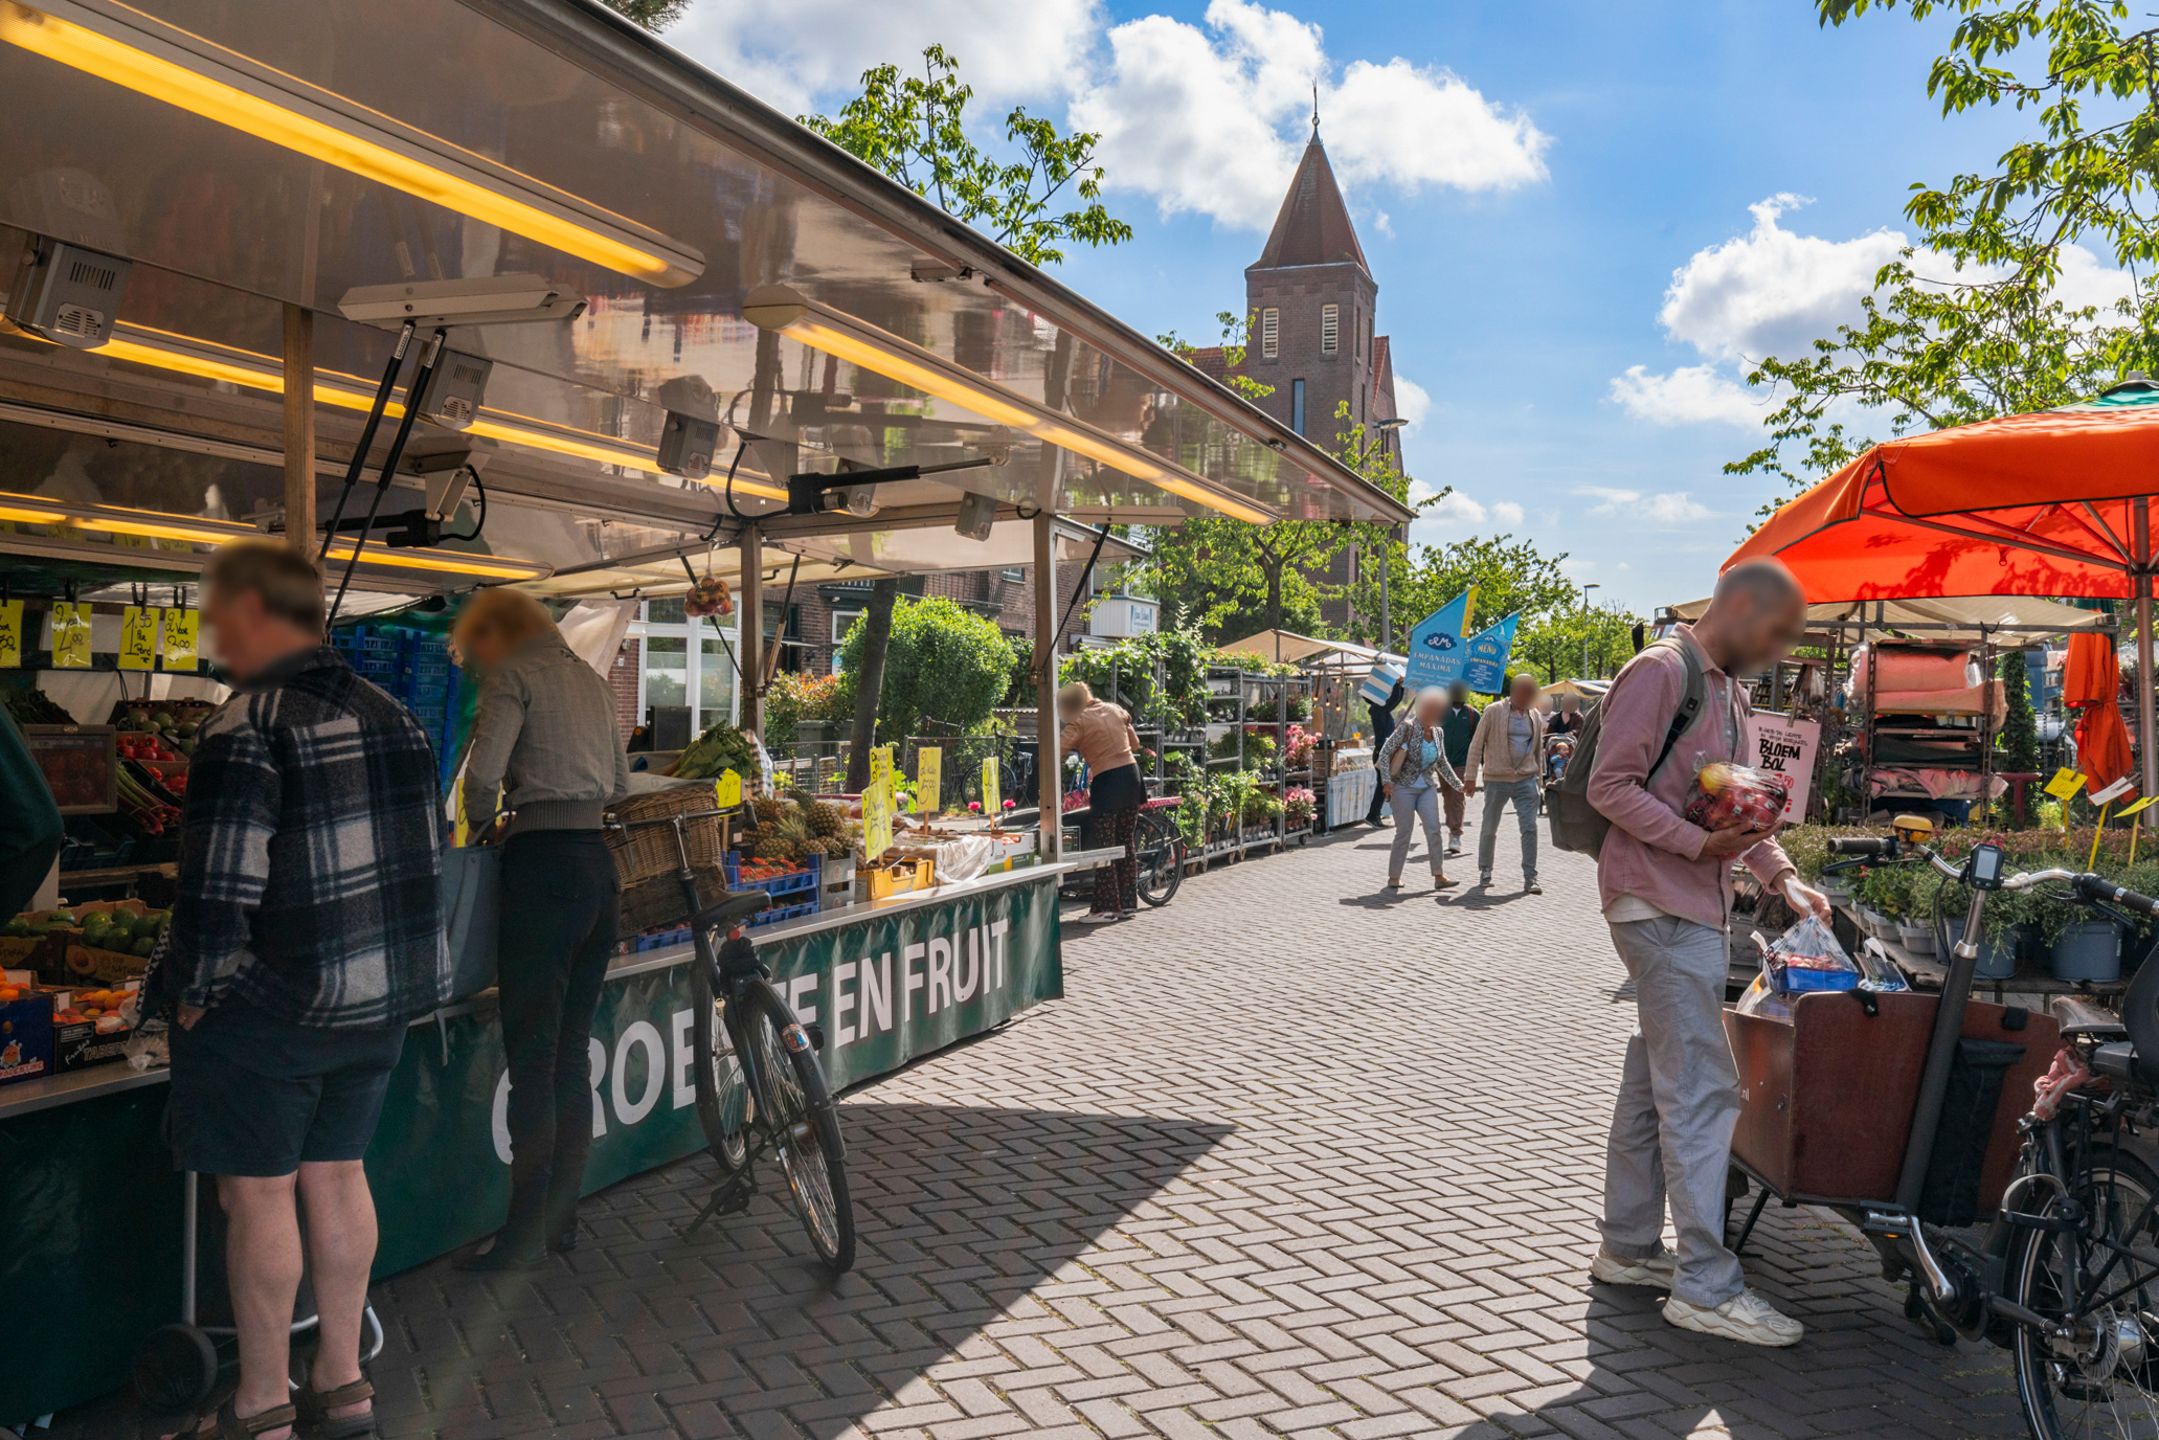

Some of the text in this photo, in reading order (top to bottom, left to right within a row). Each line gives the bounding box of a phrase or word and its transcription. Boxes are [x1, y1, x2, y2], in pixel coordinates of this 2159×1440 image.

[1413, 651, 1462, 666] EMPANADAS
[1759, 738, 1801, 760] BLOEM
[1760, 755, 1786, 771] BOL
[834, 952, 893, 1049] EN
[904, 918, 1009, 1023] FRUIT
